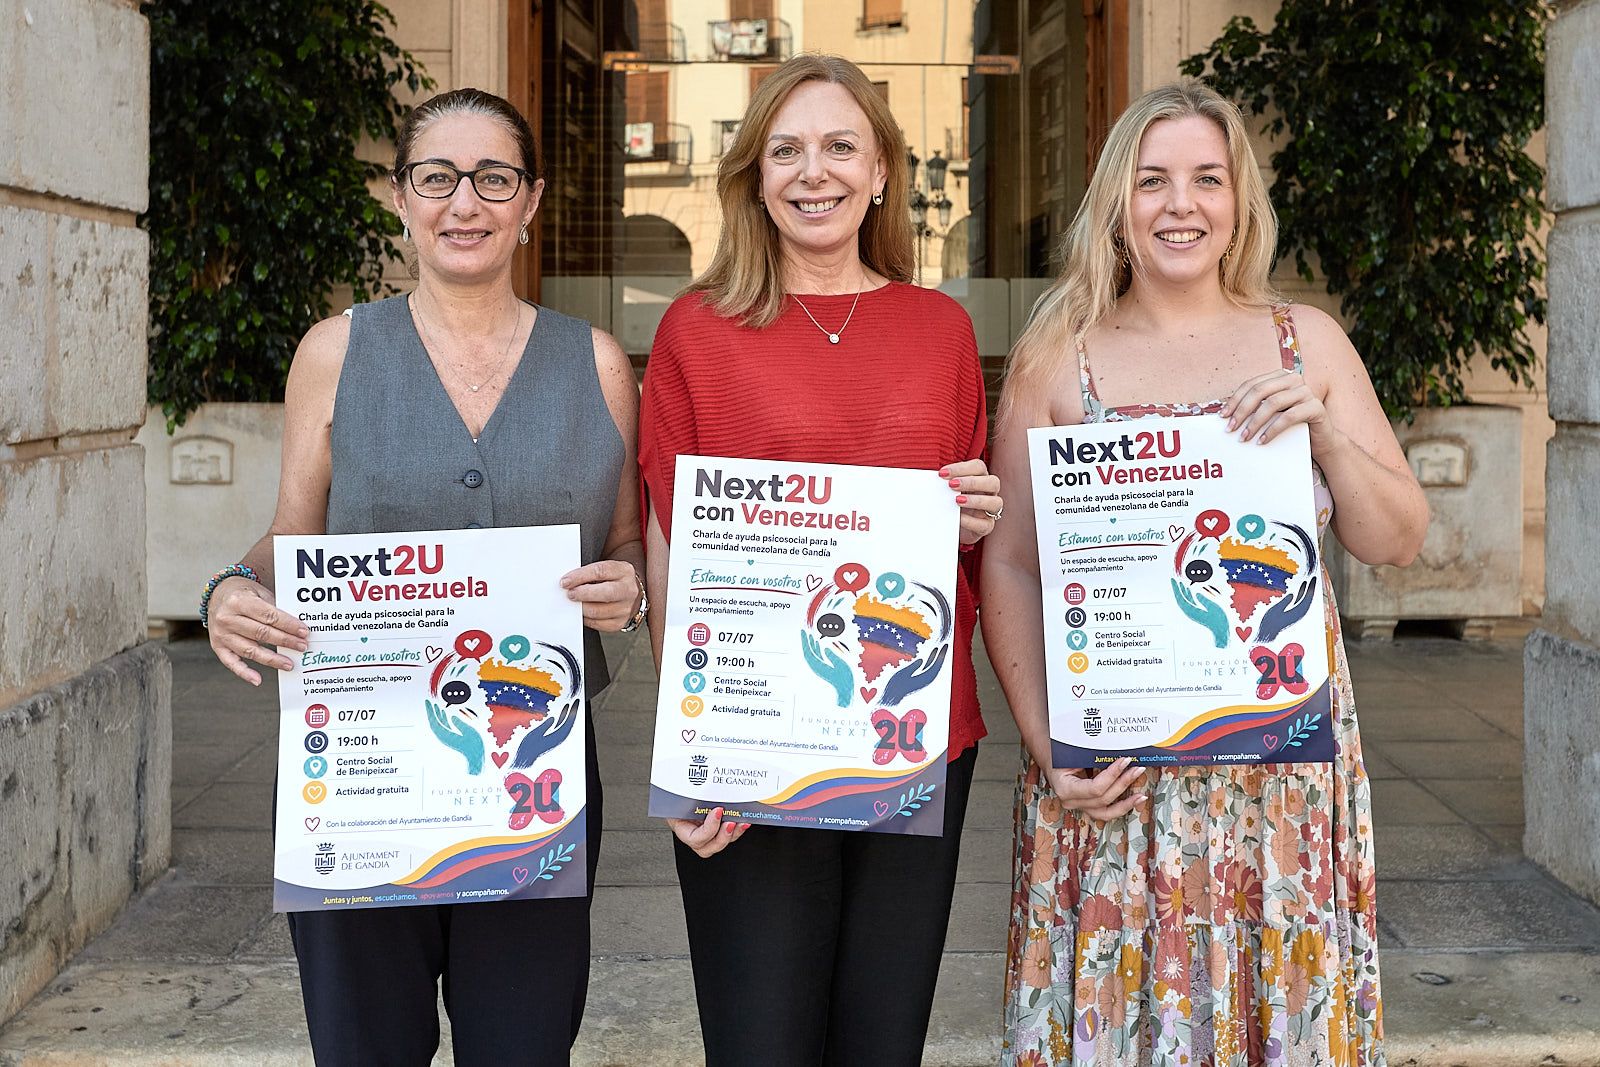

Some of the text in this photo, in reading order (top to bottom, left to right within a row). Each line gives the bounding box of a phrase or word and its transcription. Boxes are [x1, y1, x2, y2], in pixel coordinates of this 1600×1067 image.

[1049, 430, 1181, 466] Next2U
[1052, 457, 1223, 487] con Venezuela
[695, 469, 832, 505] Next2U
[1095, 493, 1119, 503] ayuda
[1121, 490, 1164, 501] psicosocial
[1056, 505, 1100, 514] comunidad
[1101, 502, 1146, 511] venezolana
[1161, 499, 1188, 507] Gandía
[693, 502, 870, 531] con Venezuela
[693, 530, 720, 538] Charla
[735, 533, 760, 542] ayuda
[763, 534, 807, 544] psicosocial
[830, 538, 837, 546] la
[1059, 532, 1102, 546] Estamos
[1128, 528, 1164, 541] vosotros
[692, 543, 830, 556] comunidad venezolana de Gandía
[297, 545, 443, 578] Next2U
[1072, 557, 1096, 565] espacio
[1068, 564, 1123, 573] acompañamiento
[691, 569, 736, 584] Estamos
[763, 574, 802, 588] vosotros
[297, 575, 488, 602] con Venezuela
[1093, 588, 1126, 599] 07/07
[299, 612, 328, 621] Charla
[345, 611, 371, 620] ayuda
[375, 609, 422, 619] psicosocial
[447, 607, 454, 615] la
[695, 605, 754, 615] acompañamiento
[1094, 611, 1131, 621] 19:00 h
[307, 622, 351, 633] munidad
[352, 621, 402, 630] venezolana
[418, 619, 448, 627] Gandía
[719, 632, 753, 643] 07/07
[1123, 630, 1145, 638] Social
[1107, 640, 1150, 648] Benipeixcar
[301, 648, 420, 666] Estamos con vosotros
[717, 657, 754, 667] 19:00 h
[1097, 657, 1162, 666] Actividad gratuita
[1205, 667, 1248, 676] NEXT
[316, 677, 343, 686] espacio
[715, 677, 766, 687] Centro Social
[311, 684, 373, 694] acompañamiento
[726, 686, 771, 696] Benipeixcar
[712, 705, 748, 714] Actividad
[339, 710, 375, 721] 07/07
[822, 725, 867, 736] NEXT
[338, 735, 378, 746] 19:00 h
[769, 740, 809, 749] Ayuntamiento
[337, 756, 392, 766] Centro Social
[1139, 754, 1177, 762] escuchamos,
[1217, 753, 1261, 761] acompañamos.
[349, 765, 398, 776] Benipeixcar
[726, 777, 757, 786] GANDIA
[336, 786, 409, 795] Actividad gratuita
[454, 795, 501, 805] NEXT
[400, 817, 441, 825] Ayuntamiento
[722, 809, 742, 818] untos,
[742, 811, 781, 820] escuchamos,
[824, 818, 869, 826] acompañamos.
[355, 861, 389, 869] GANDIA
[351, 896, 373, 904] juntos,
[462, 889, 509, 898] acompañamos.
